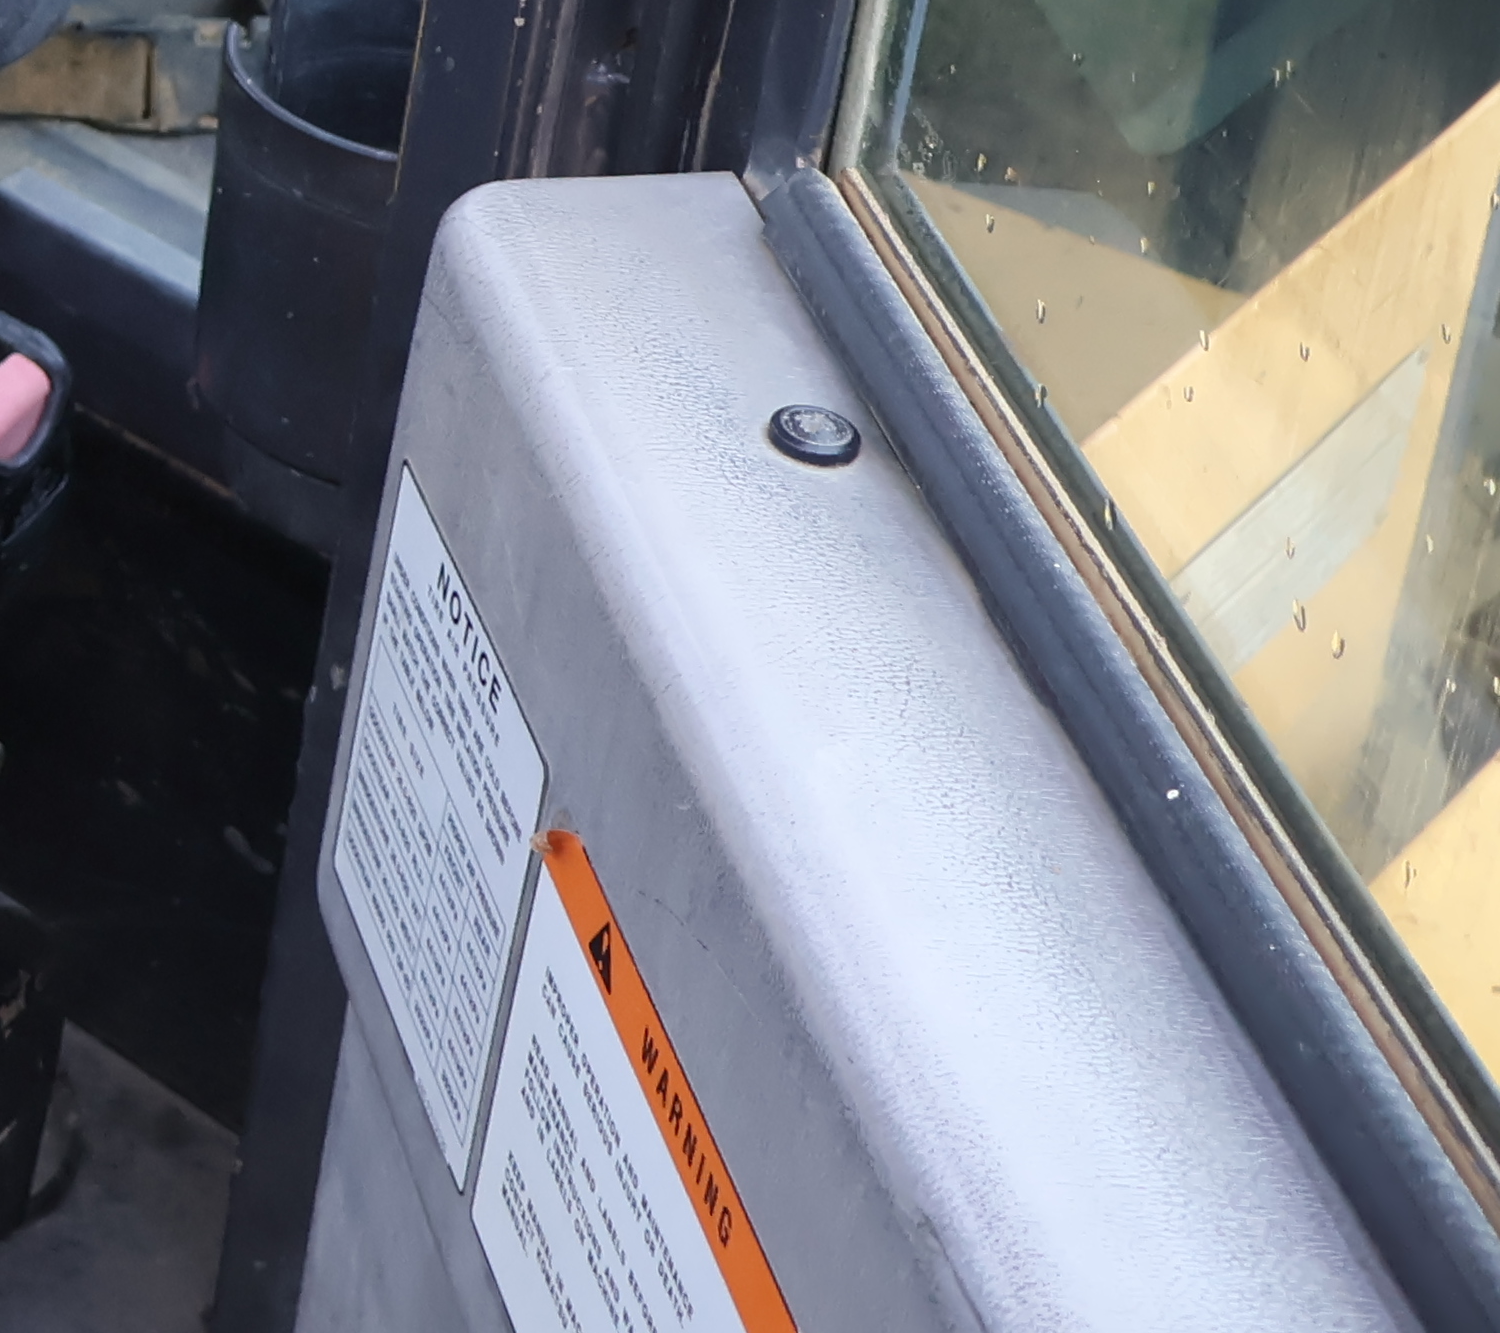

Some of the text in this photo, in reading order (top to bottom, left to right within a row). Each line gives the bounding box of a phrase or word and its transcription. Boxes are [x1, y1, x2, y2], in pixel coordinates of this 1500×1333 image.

[427, 584, 499, 746] TIRE AIR PRESSURE
[436, 563, 501, 713] NOTICE
[520, 1086, 535, 1119] AND
[536, 1122, 545, 1145] IN
[545, 1147, 572, 1214] LABELS
[573, 1217, 586, 1246] ON
[524, 1067, 551, 1134] FOLLOW
[552, 1138, 601, 1260] INSTRUCTIONS
[603, 1266, 620, 1303] AND
[531, 1033, 549, 1079] READ
[551, 1082, 577, 1152] MANUAL
[580, 1157, 595, 1193] AND
[597, 1196, 625, 1266] LABELS
[541, 983, 556, 1020] CAN
[557, 1022, 581, 1078] CAUSE
[582, 1081, 612, 1156] SERIOUS
[614, 1159, 642, 1221] INJURY
[643, 1227, 655, 1257] OR
[545, 966, 693, 1319] IMPROPER OPERATION AND MAINTENANCE
[641, 1023, 732, 1250] WARNING
[504, 1166, 569, 1329] CONTACT KOMATSU
[507, 1149, 525, 1191] KEEP
[526, 1198, 552, 1269] MANUAL
[555, 1271, 564, 1294] IN
